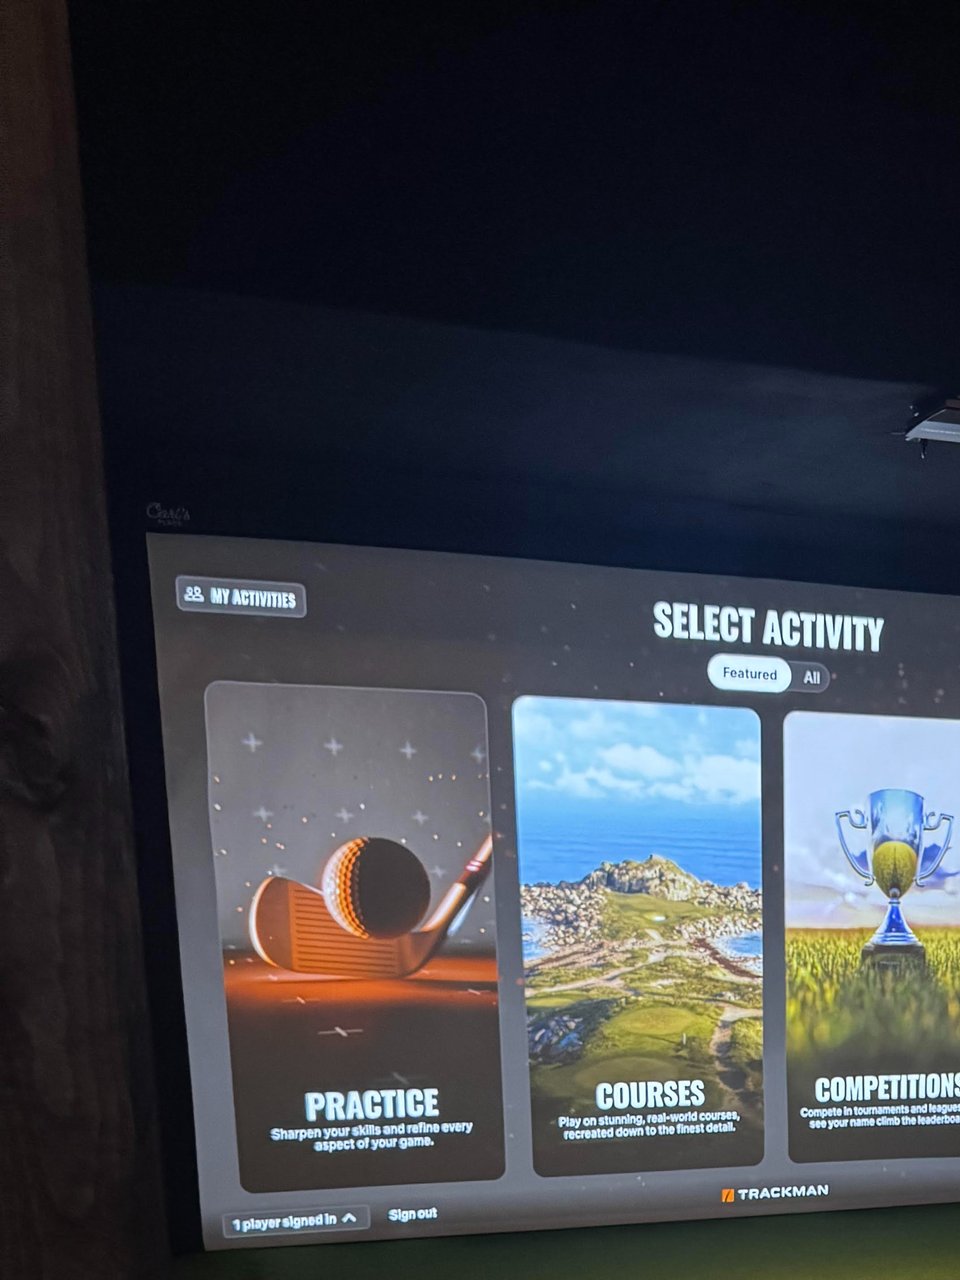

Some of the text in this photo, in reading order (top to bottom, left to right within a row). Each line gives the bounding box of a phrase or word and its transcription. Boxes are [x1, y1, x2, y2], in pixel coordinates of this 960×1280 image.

[210, 588, 296, 609] MY ACTIVITIES
[653, 601, 884, 652] SELECT ACTIVITY
[724, 667, 777, 681] Featured
[804, 670, 821, 685] All
[596, 1080, 705, 1110] COURSES
[304, 1088, 440, 1122] PRACTICE
[800, 1107, 842, 1119] Compete
[844, 1106, 852, 1116] in
[854, 1105, 909, 1116] tournaments
[911, 1104, 928, 1114] and
[558, 1111, 741, 1129] Play on stunning, real-world courses,
[809, 1120, 826, 1129] see
[827, 1119, 849, 1130] your
[850, 1117, 875, 1127] name
[876, 1114, 900, 1126] climb
[901, 1115, 917, 1126] the
[271, 1122, 474, 1142] Sharpen your skills and refine every
[564, 1122, 736, 1140] recreated down to the finest detail.
[314, 1136, 434, 1153] aspect of your game.
[738, 1185, 829, 1201] TRACKMAN
[232, 1213, 337, 1233] 1 player signed in
[388, 1207, 438, 1223] Sign out
